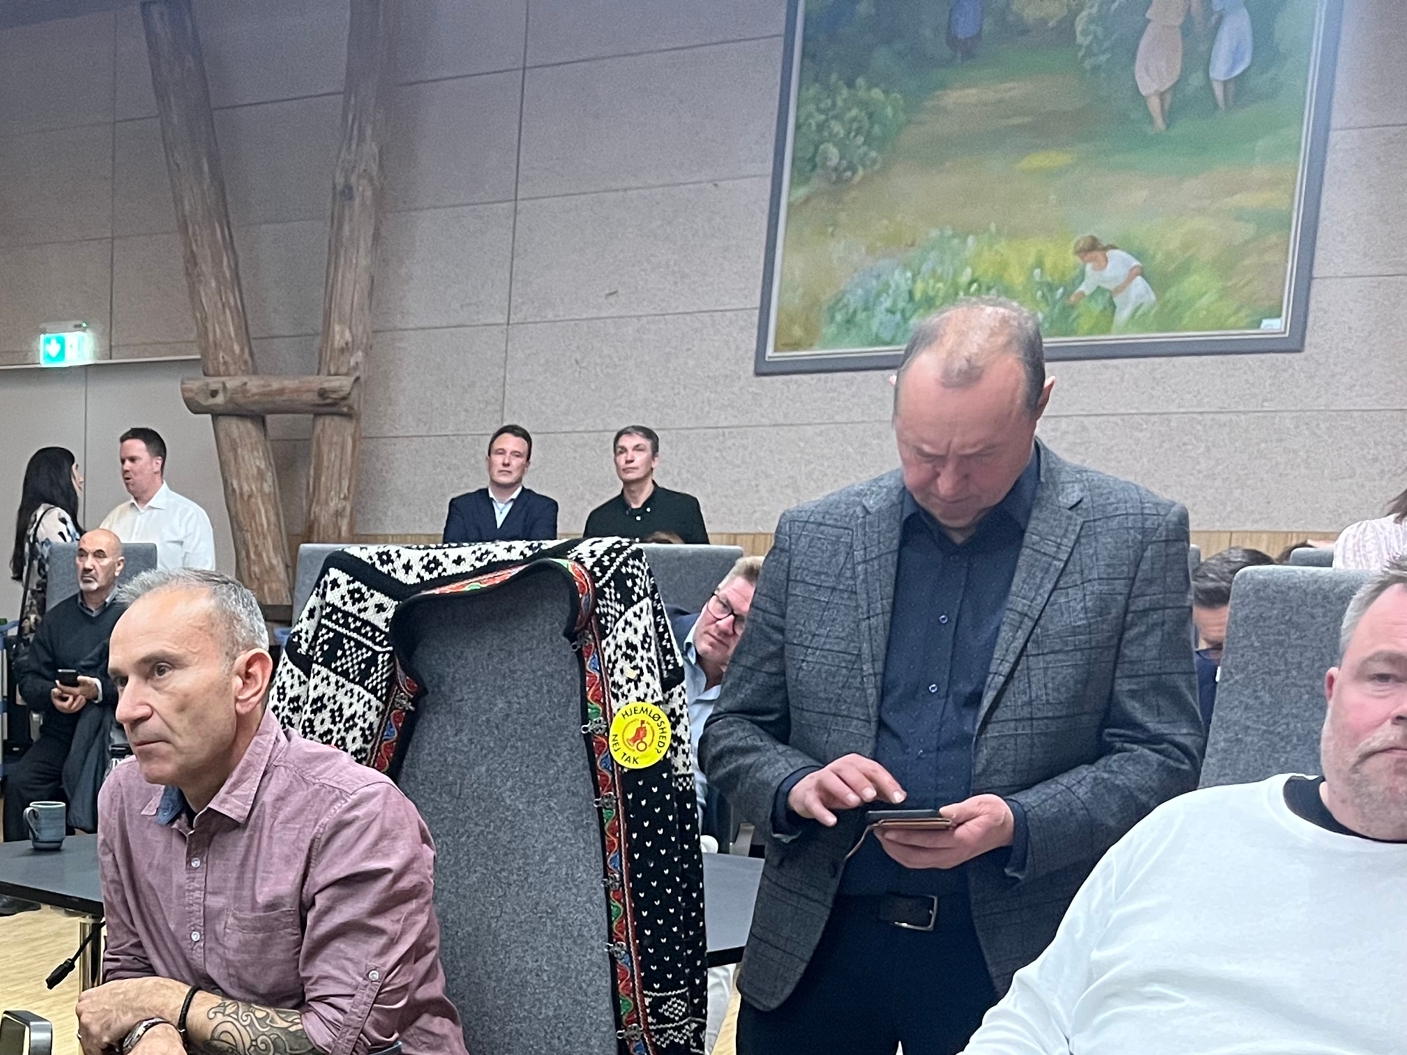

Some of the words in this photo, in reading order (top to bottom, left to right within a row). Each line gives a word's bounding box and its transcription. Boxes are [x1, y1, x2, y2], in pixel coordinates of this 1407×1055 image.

[612, 733, 621, 753] NEJ
[620, 752, 640, 765] TAK
[621, 706, 667, 754] HJEMLØSHED?
